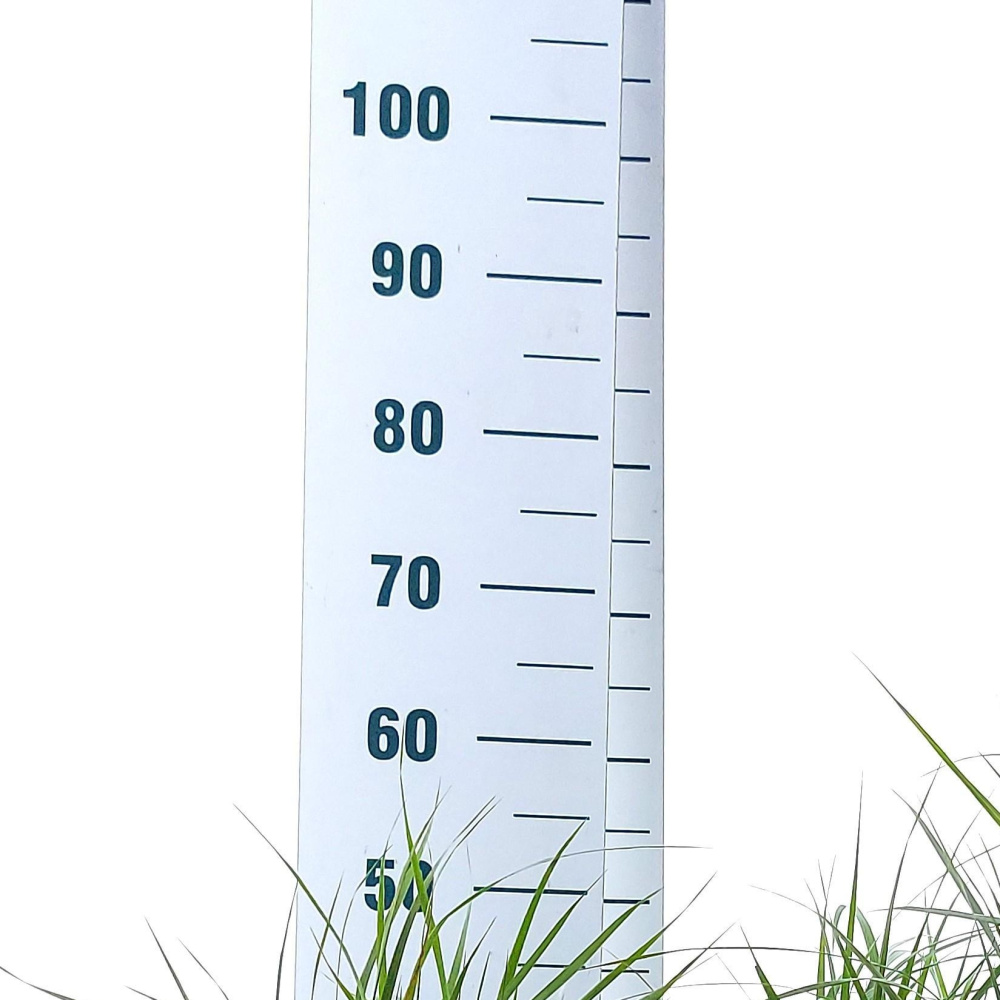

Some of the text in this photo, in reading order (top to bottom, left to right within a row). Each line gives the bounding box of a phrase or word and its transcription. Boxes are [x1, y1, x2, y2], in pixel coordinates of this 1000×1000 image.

[342, 81, 451, 141] 100
[371, 242, 443, 299] 90
[373, 398, 444, 455] 80
[370, 554, 441, 610] 70
[367, 707, 438, 762] 60
